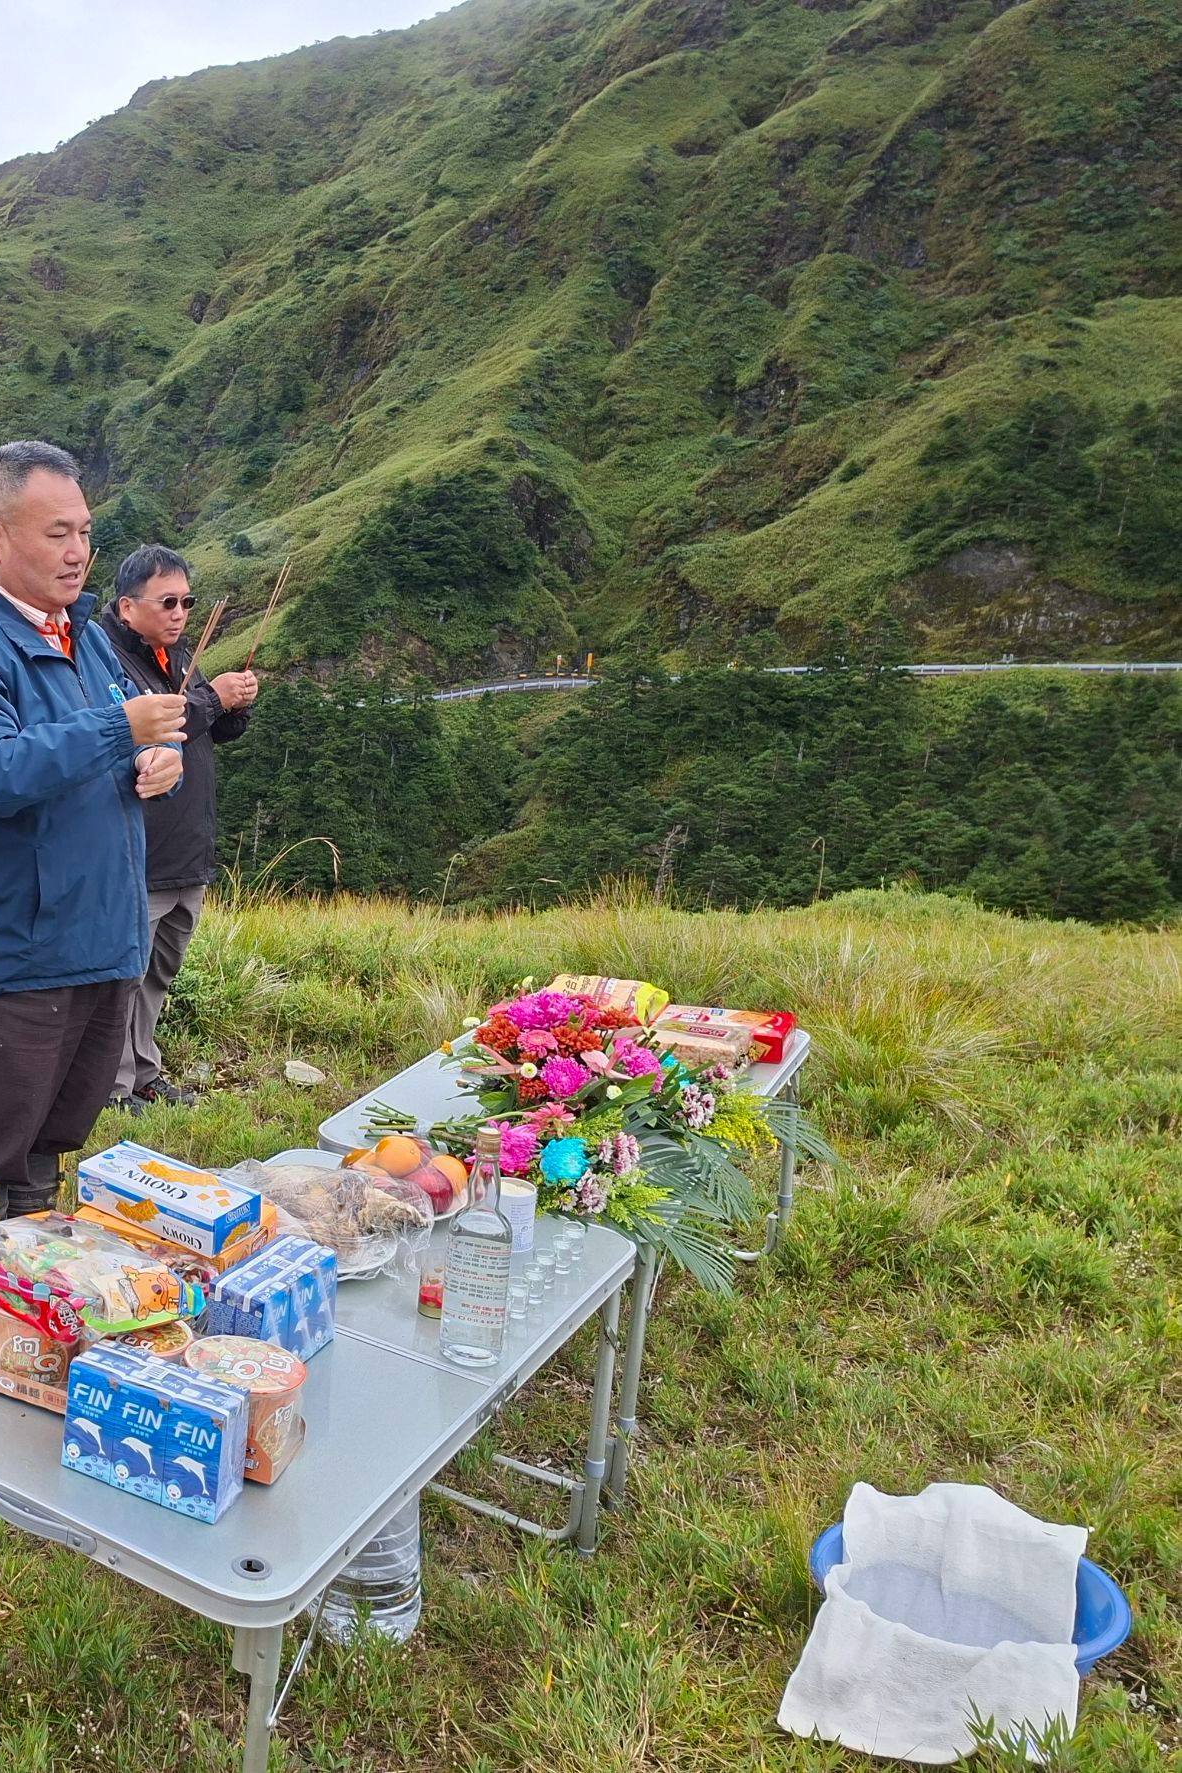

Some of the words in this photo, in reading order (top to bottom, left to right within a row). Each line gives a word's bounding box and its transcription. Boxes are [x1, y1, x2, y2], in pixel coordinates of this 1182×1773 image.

[123, 1169, 188, 1200] CROWN
[225, 1203, 251, 1223] CROWN
[162, 1225, 203, 1250] CROWN
[73, 1383, 114, 1411] FIN
[121, 1402, 163, 1430] FIN
[174, 1421, 217, 1449] FIN
